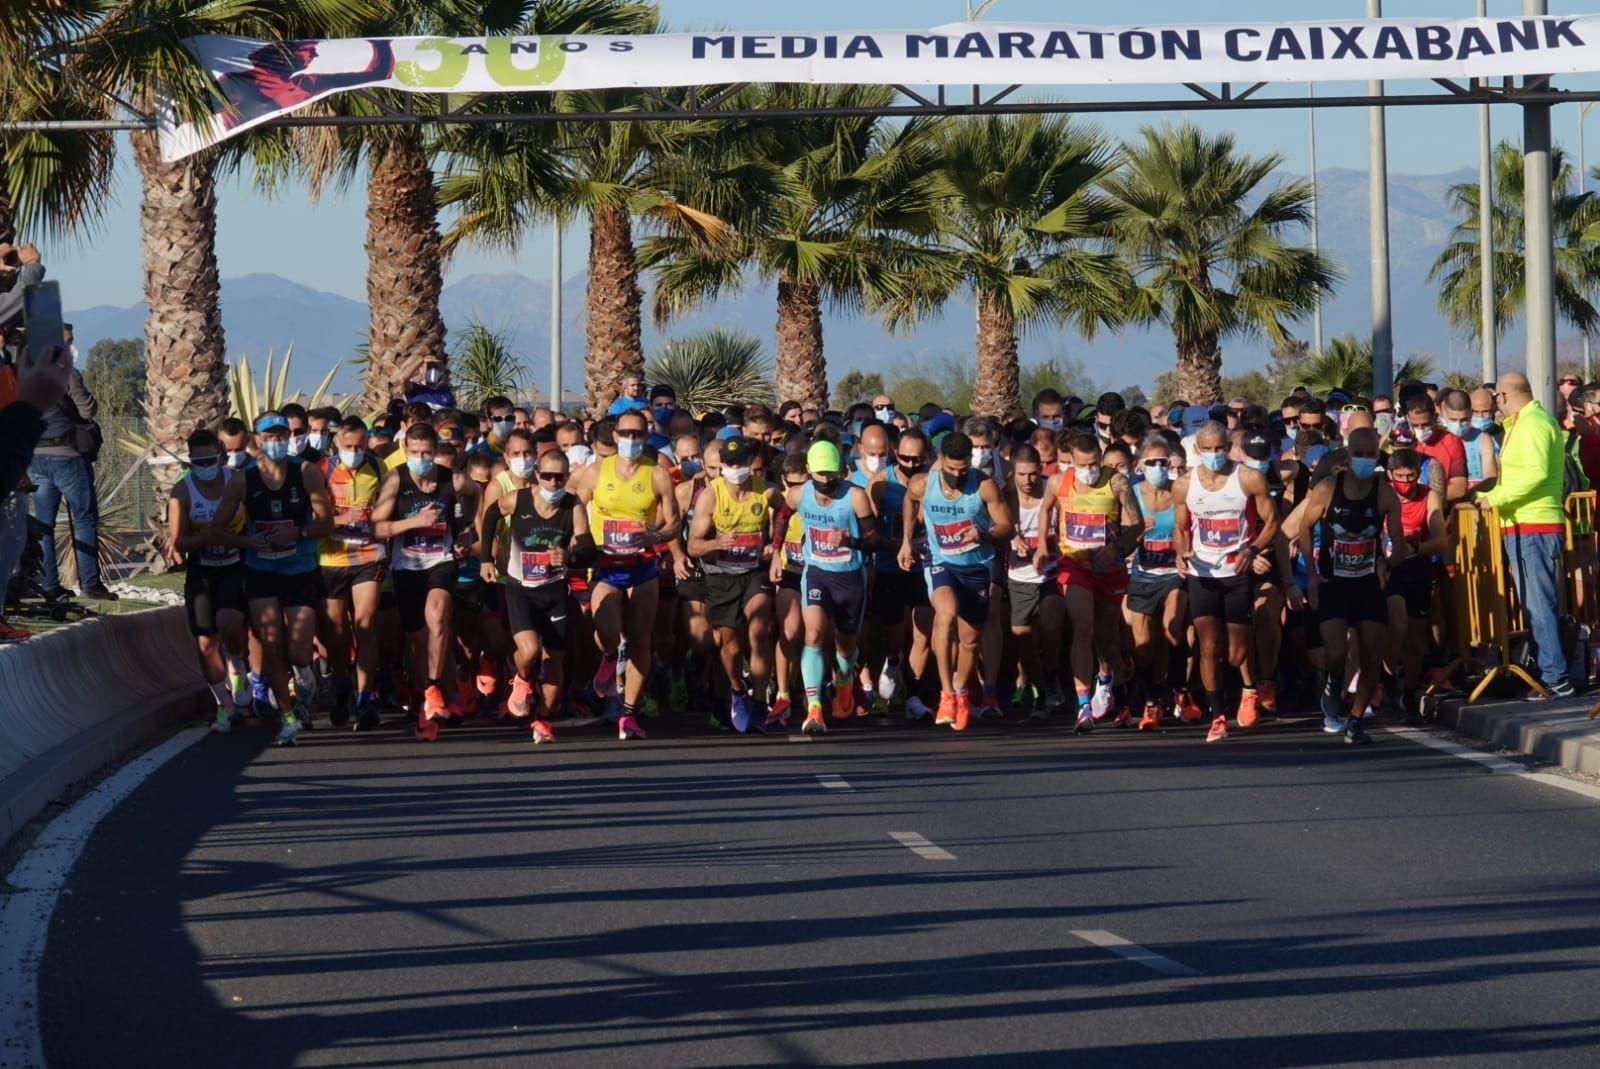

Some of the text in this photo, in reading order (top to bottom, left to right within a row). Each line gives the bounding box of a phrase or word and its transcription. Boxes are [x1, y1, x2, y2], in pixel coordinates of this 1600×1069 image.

[460, 40, 633, 55] AÑOS
[692, 35, 883, 59] MEDIA
[1224, 19, 1586, 62] CAIXABANK
[394, 37, 566, 88] 30
[930, 504, 965, 516] nerja
[803, 511, 835, 524] nerja
[1072, 525, 1086, 535] 77
[1207, 531, 1221, 540] 64
[610, 532, 629, 542] 164
[532, 565, 546, 574] 45
